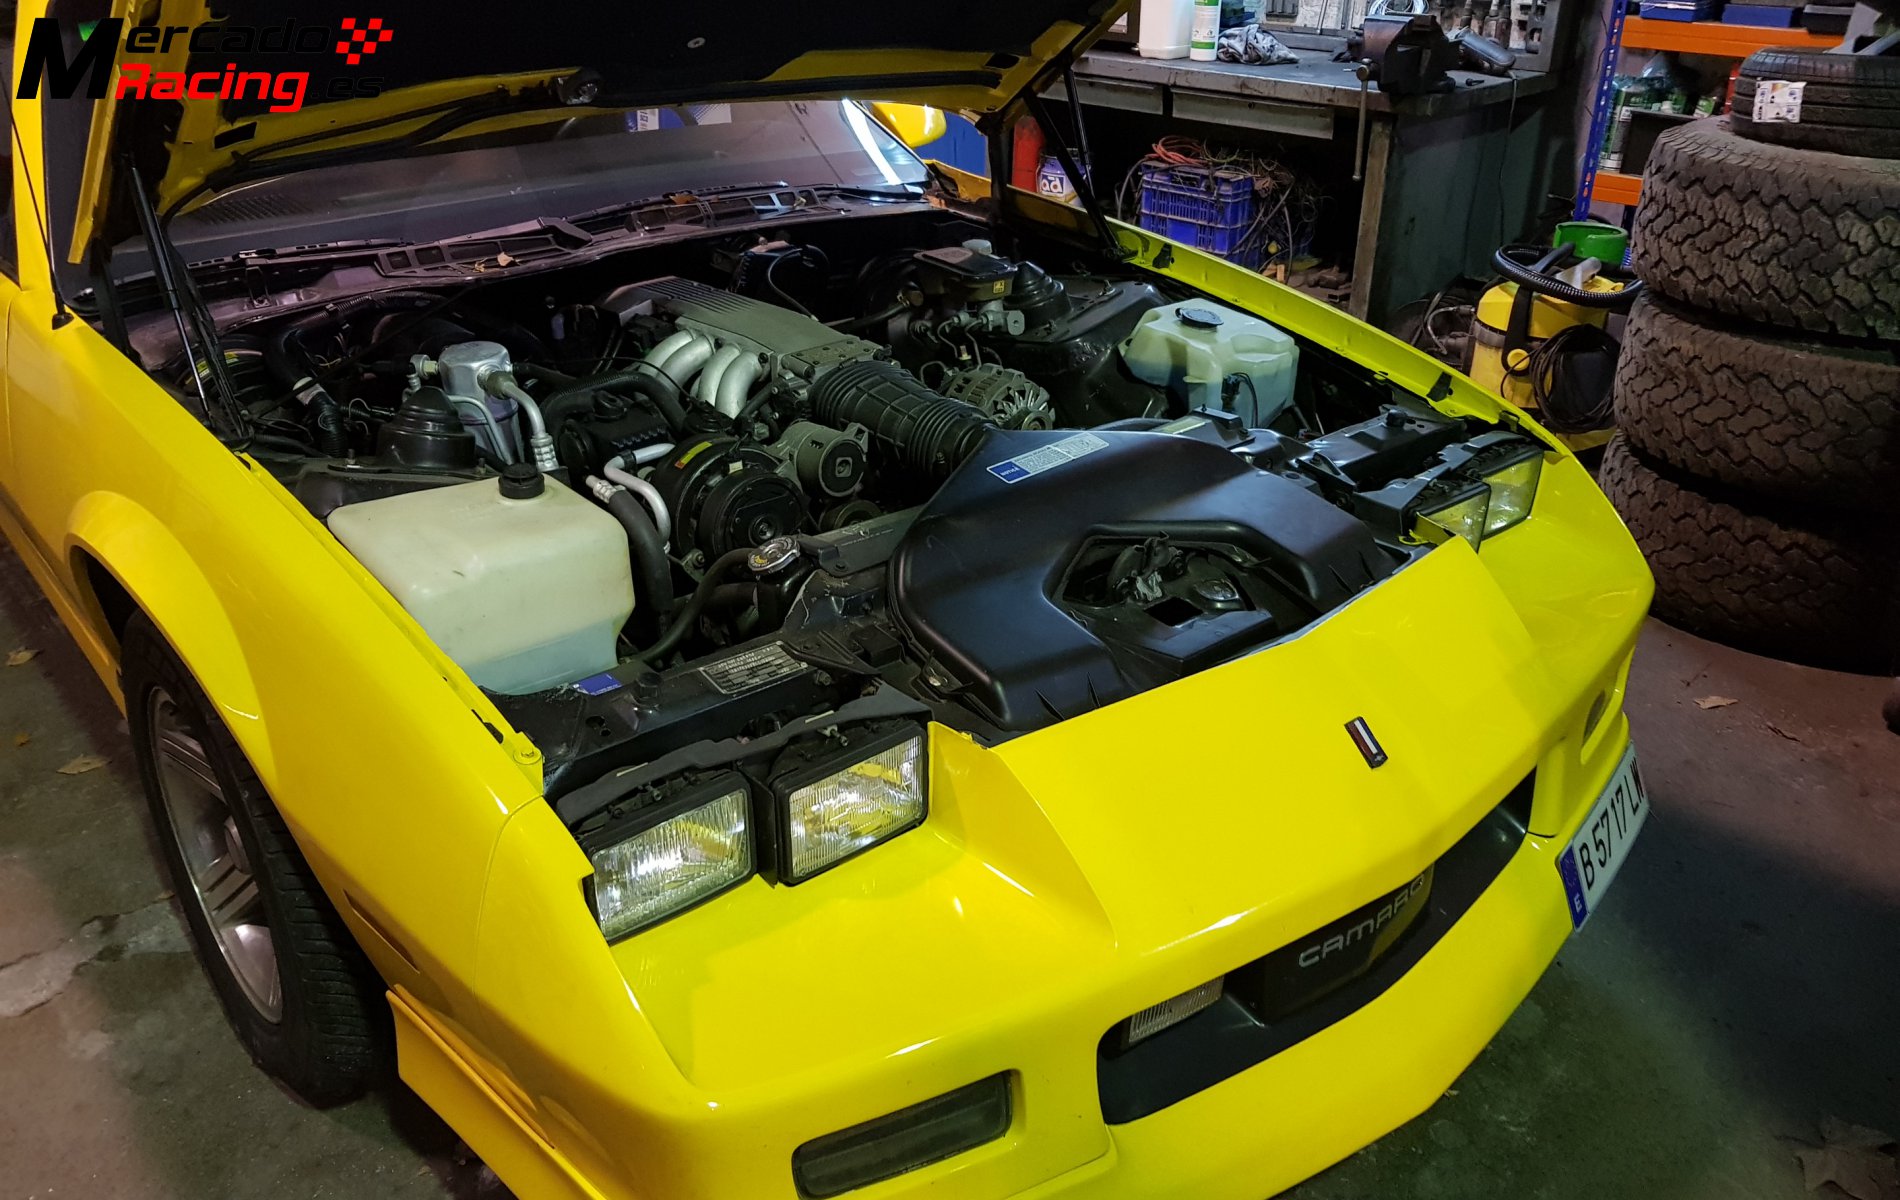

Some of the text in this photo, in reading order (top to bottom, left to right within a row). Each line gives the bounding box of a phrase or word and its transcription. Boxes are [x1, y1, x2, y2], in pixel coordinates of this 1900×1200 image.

[1579, 841, 1595, 891] B
[1591, 783, 1627, 868] 5717
[1299, 874, 1424, 968] CAMARO
[1573, 892, 1583, 913] E
